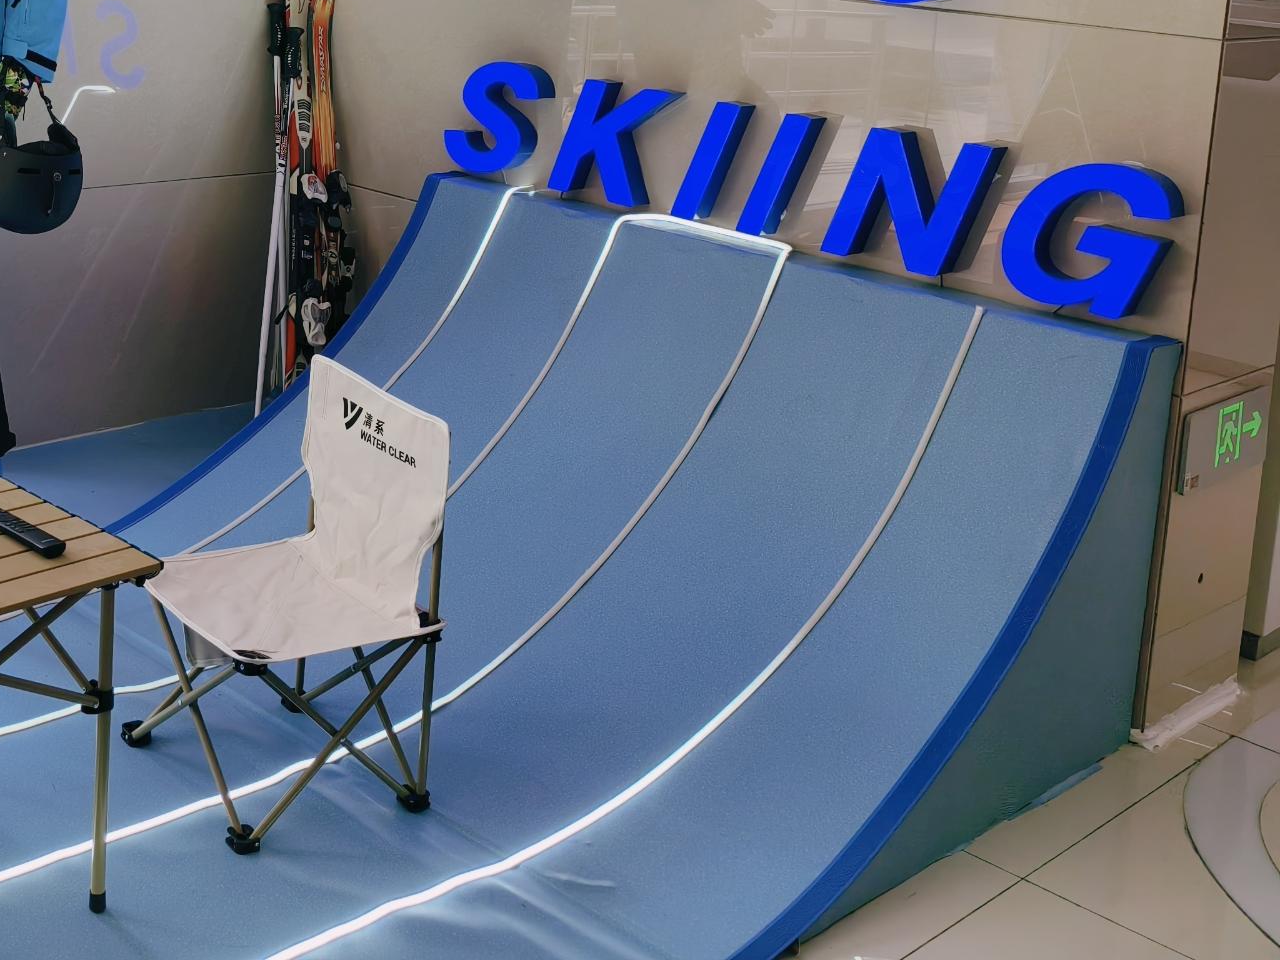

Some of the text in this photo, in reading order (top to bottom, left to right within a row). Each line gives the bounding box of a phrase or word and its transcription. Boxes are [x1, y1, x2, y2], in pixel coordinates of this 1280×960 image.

[443, 61, 1185, 320] SKIING
[360, 429, 417, 468] WATER CLEAR
